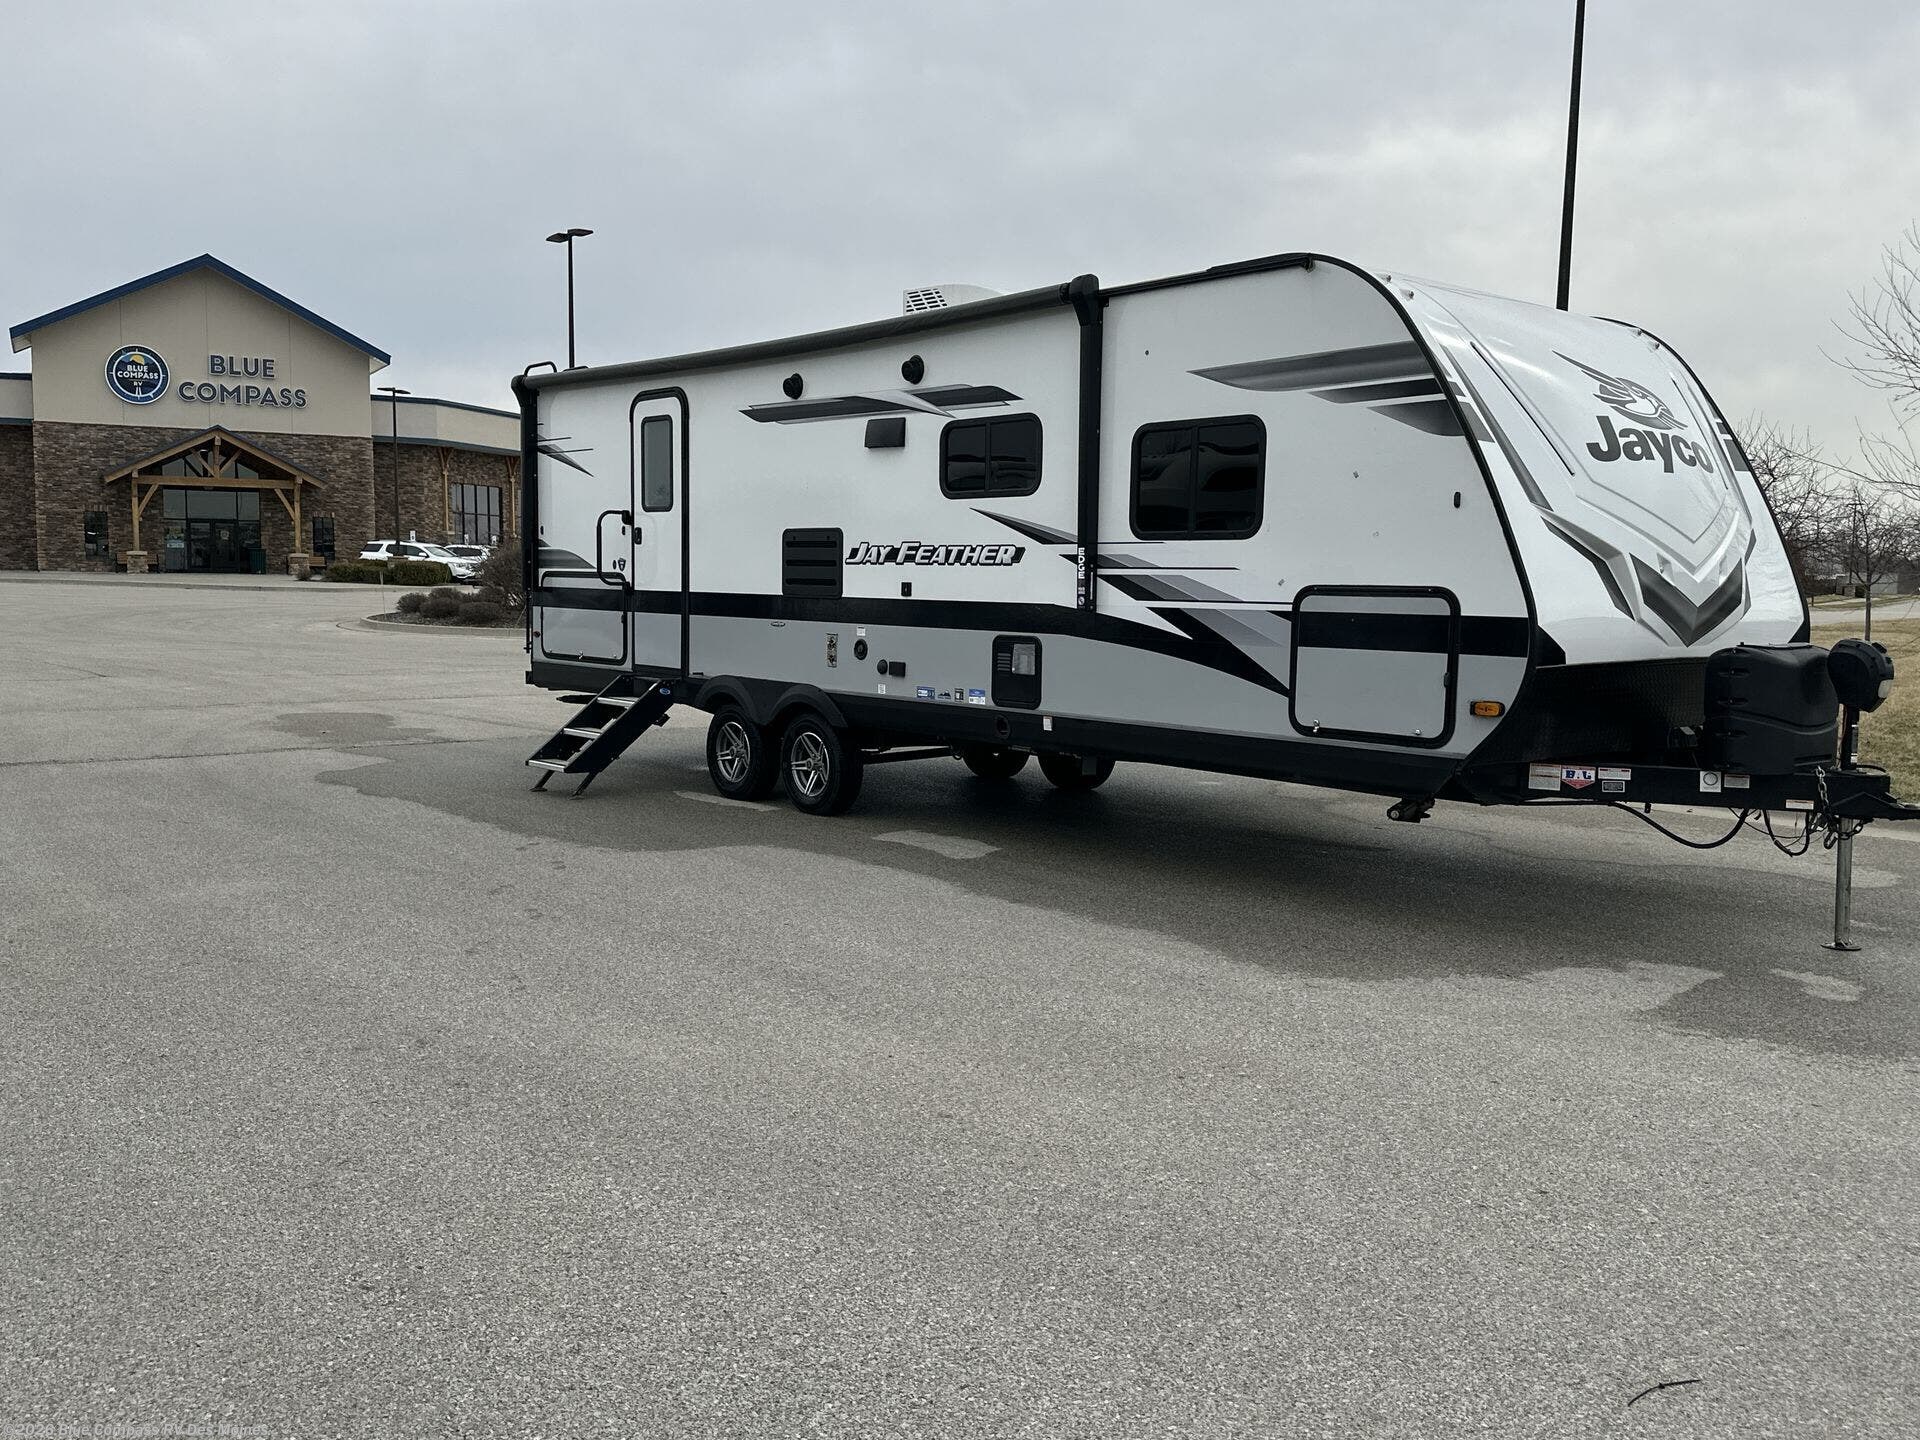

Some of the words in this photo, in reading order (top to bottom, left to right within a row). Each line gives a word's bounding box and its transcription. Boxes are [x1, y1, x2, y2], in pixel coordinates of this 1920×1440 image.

[117, 371, 159, 380] COMPASS
[127, 364, 149, 372] BLUE
[209, 354, 275, 378] BLUE
[178, 381, 307, 408] COMPASS
[1585, 415, 1714, 474] Jayco
[845, 542, 894, 565] JAY
[895, 541, 1016, 566] FEATHER
